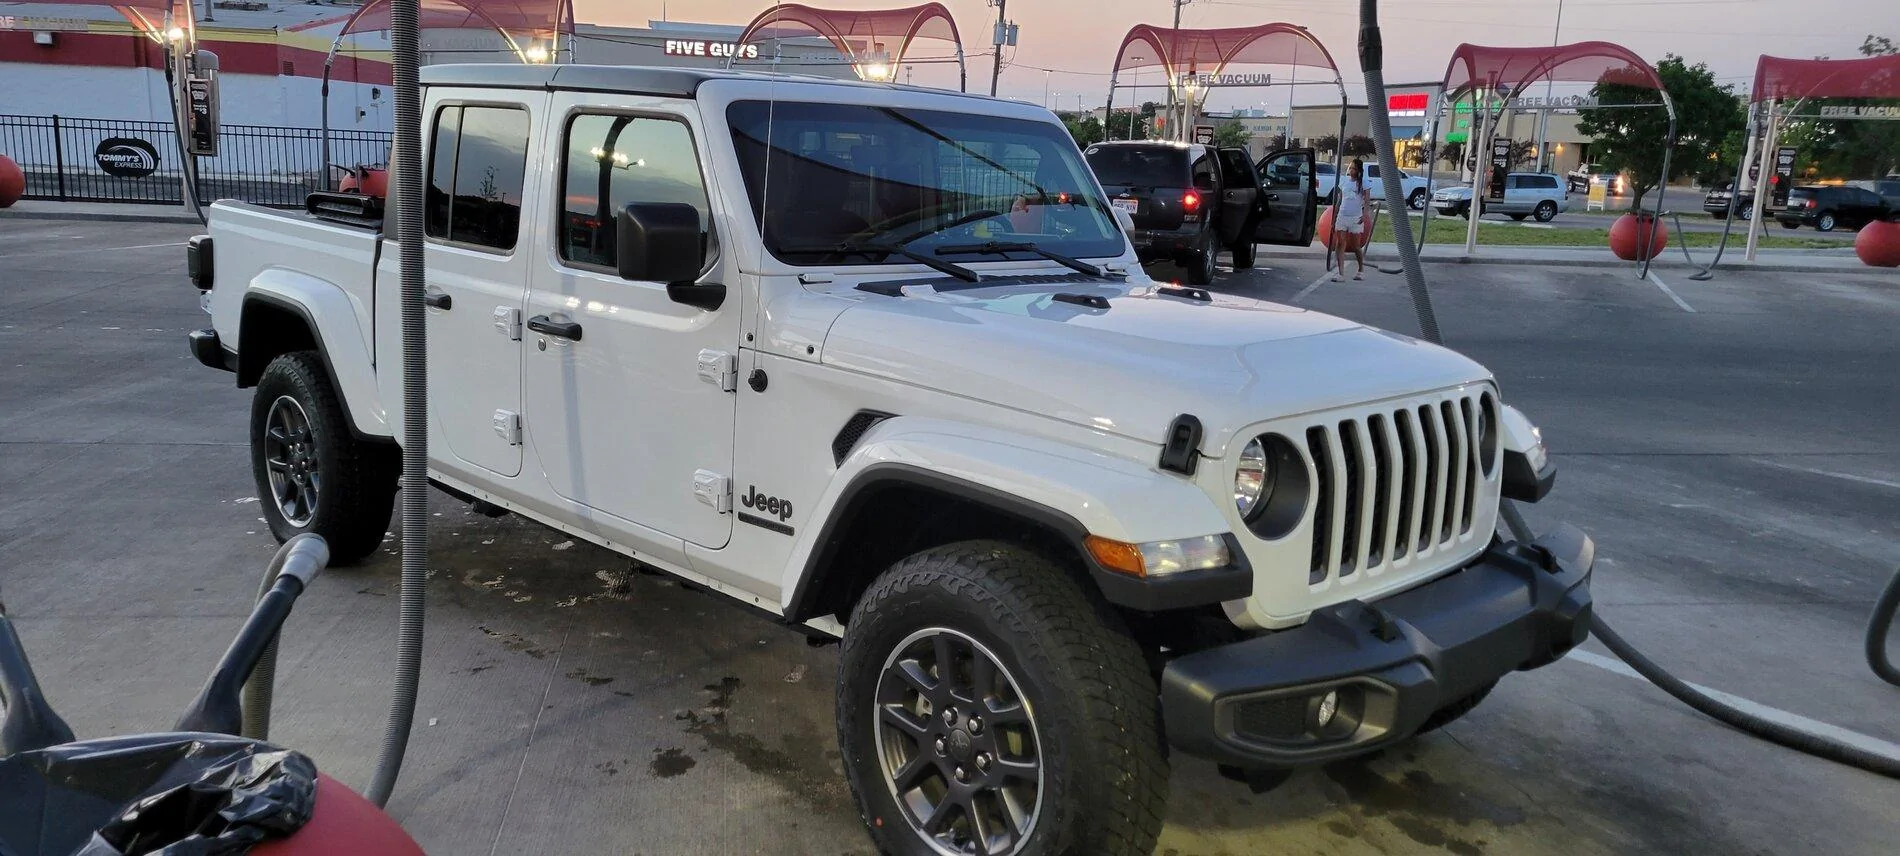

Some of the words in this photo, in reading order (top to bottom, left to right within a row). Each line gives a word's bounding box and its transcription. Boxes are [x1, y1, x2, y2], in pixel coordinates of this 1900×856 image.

[666, 40, 705, 56] FIVE
[709, 42, 758, 58] GUYS
[1218, 73, 1272, 84] VACUUM
[1820, 105, 1858, 118] FREE
[98, 154, 140, 162] TOMMY'S
[741, 484, 793, 522] Jeep
